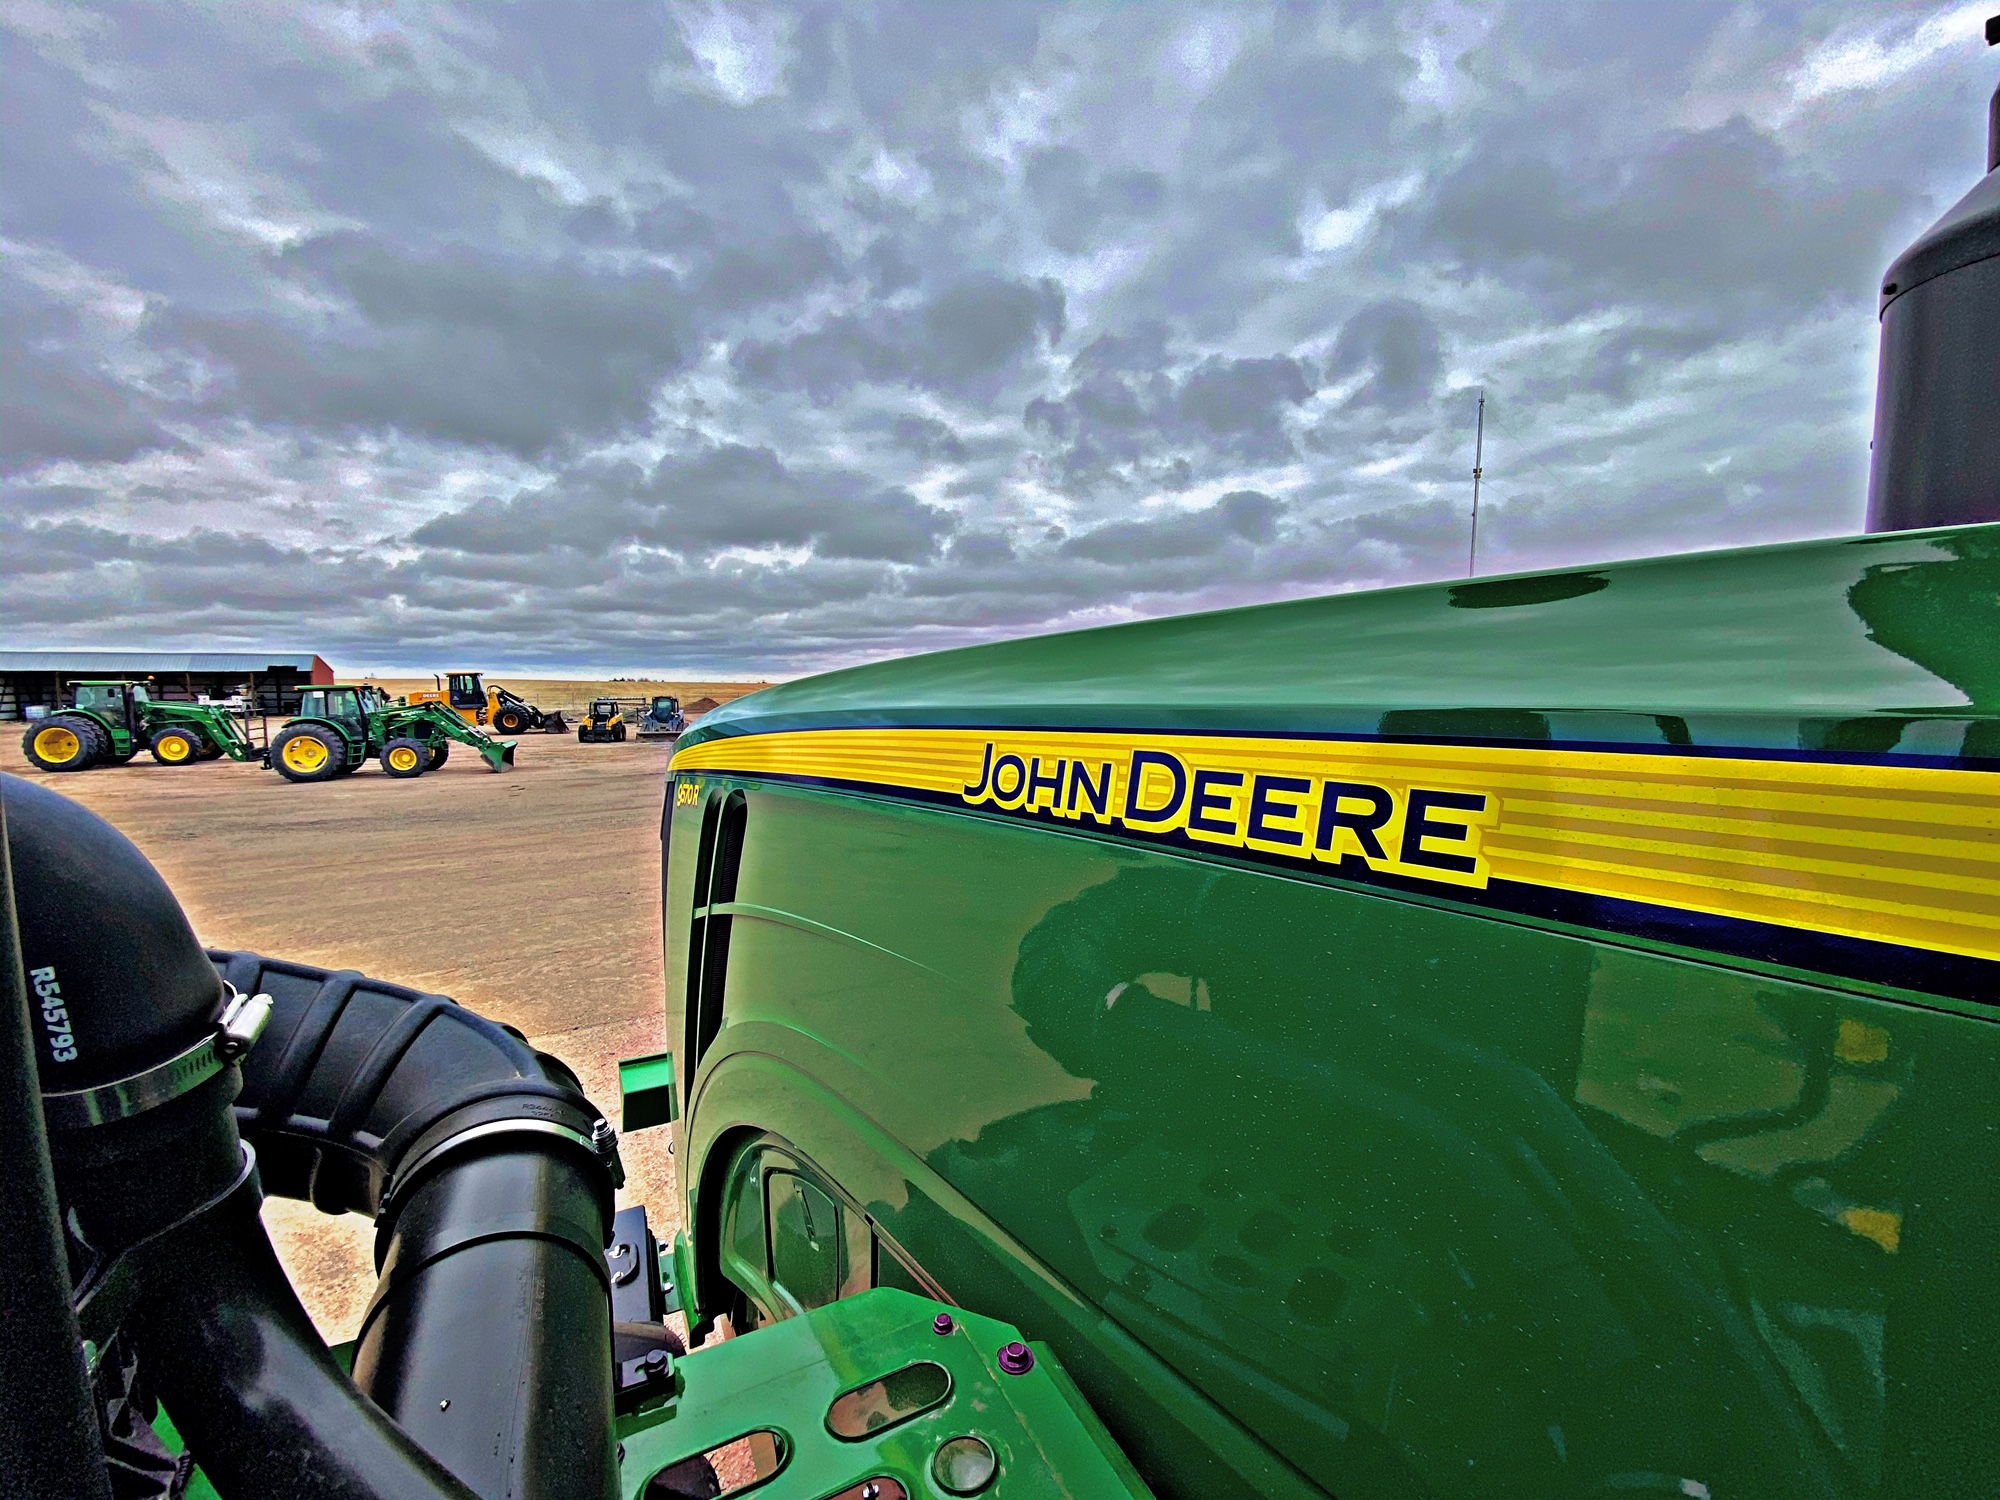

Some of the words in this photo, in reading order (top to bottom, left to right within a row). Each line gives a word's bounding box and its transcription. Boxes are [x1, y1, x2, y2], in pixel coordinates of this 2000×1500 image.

[961, 742, 1113, 820] JOHN
[1123, 749, 1489, 880] DEERE
[30, 966, 78, 1063] R545793
